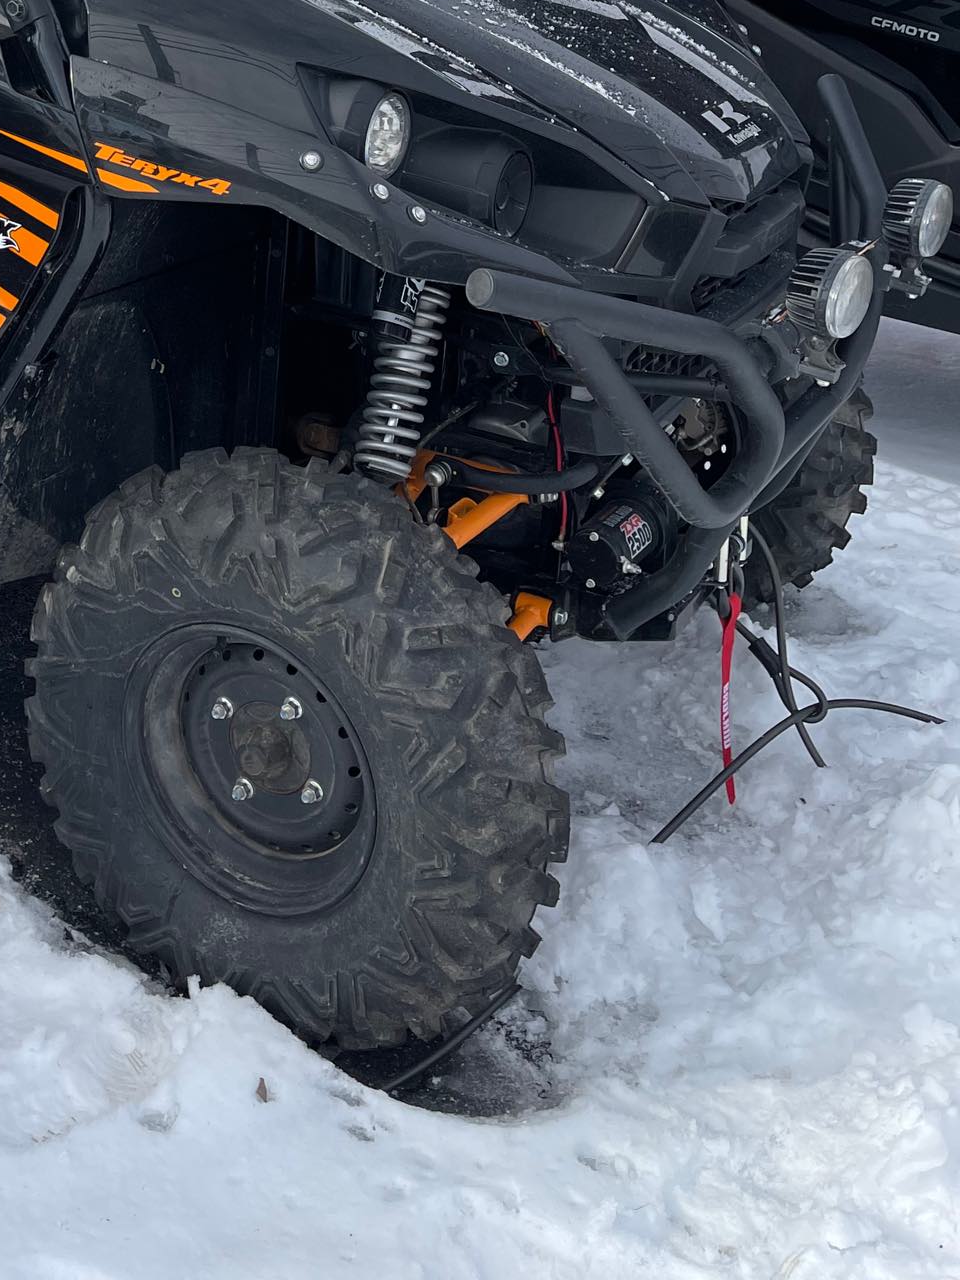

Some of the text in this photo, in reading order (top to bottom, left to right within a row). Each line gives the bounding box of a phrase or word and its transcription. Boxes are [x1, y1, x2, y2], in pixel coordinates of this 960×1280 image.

[871, 16, 940, 42] CFMOTO
[94, 141, 233, 195] TERYX4
[627, 523, 653, 559] 2500
